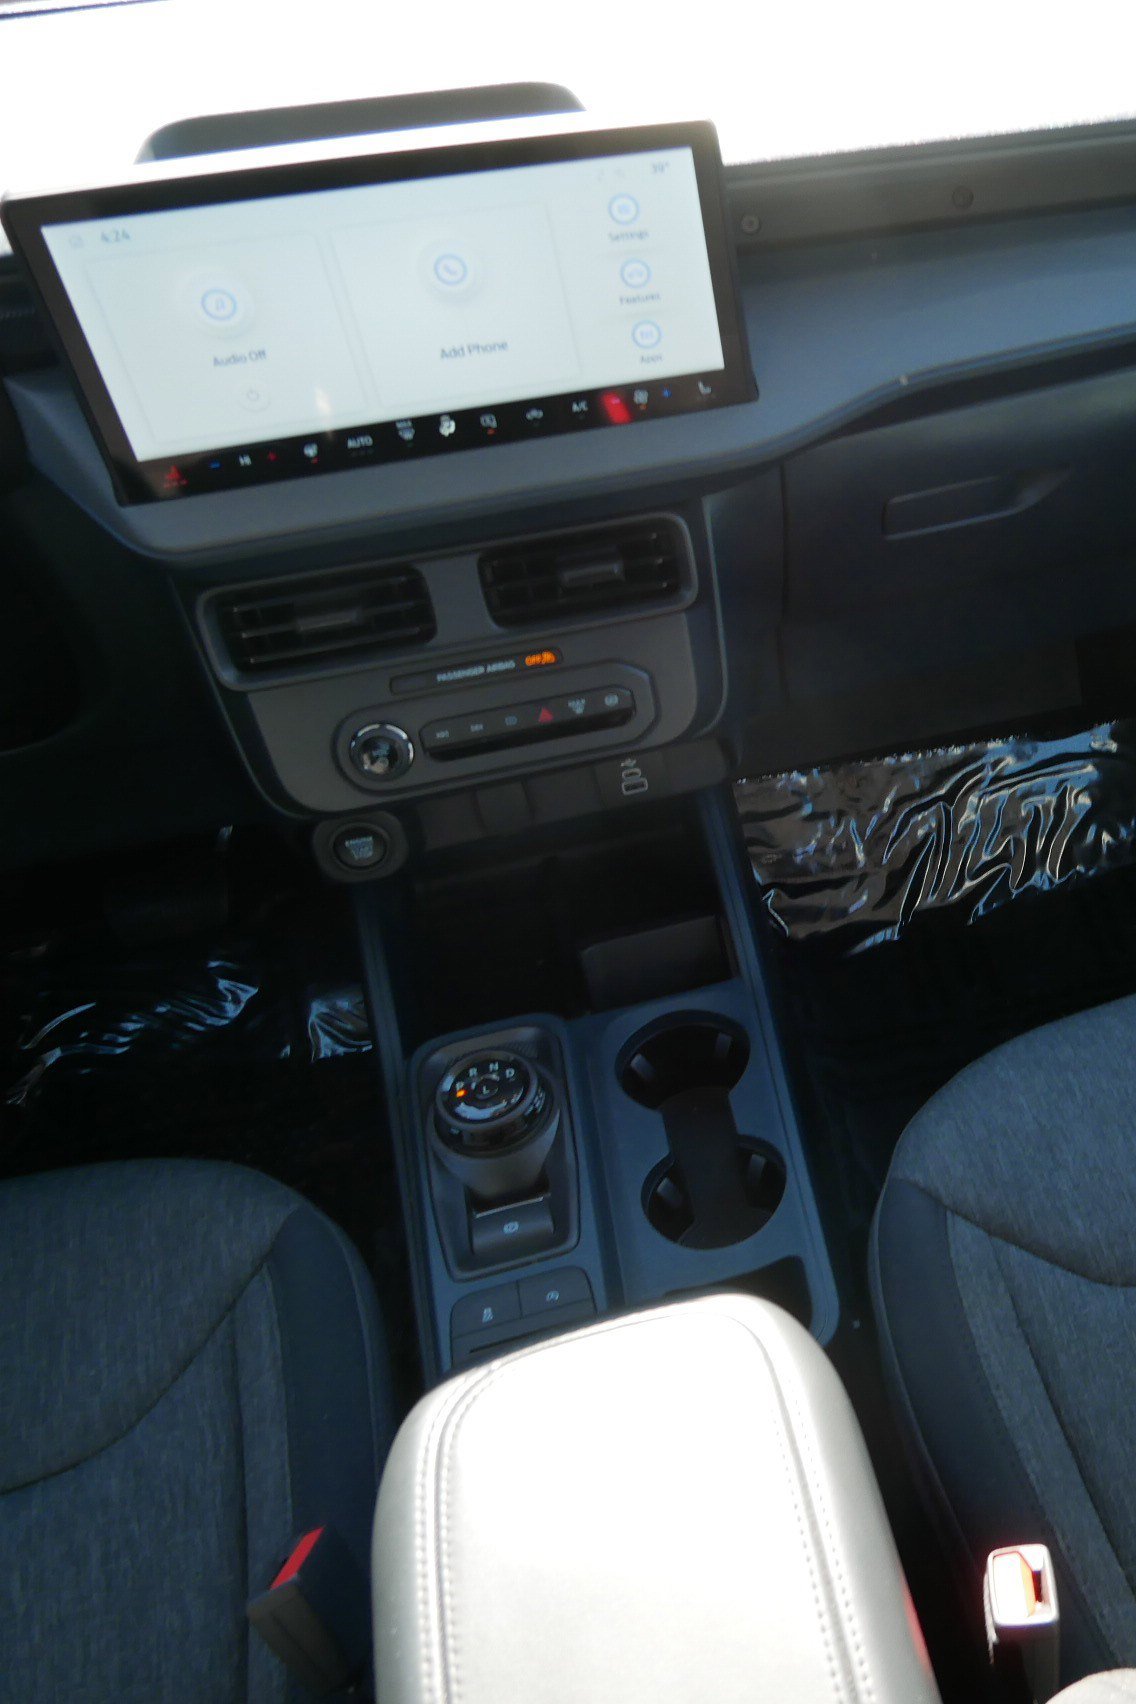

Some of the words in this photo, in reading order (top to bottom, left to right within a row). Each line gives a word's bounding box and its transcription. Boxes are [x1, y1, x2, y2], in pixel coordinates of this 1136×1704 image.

[212, 352, 247, 368] Audio
[249, 348, 267, 361] Off
[440, 344, 465, 360] Add
[467, 340, 509, 356] Phone
[347, 435, 373, 449] AUTO
